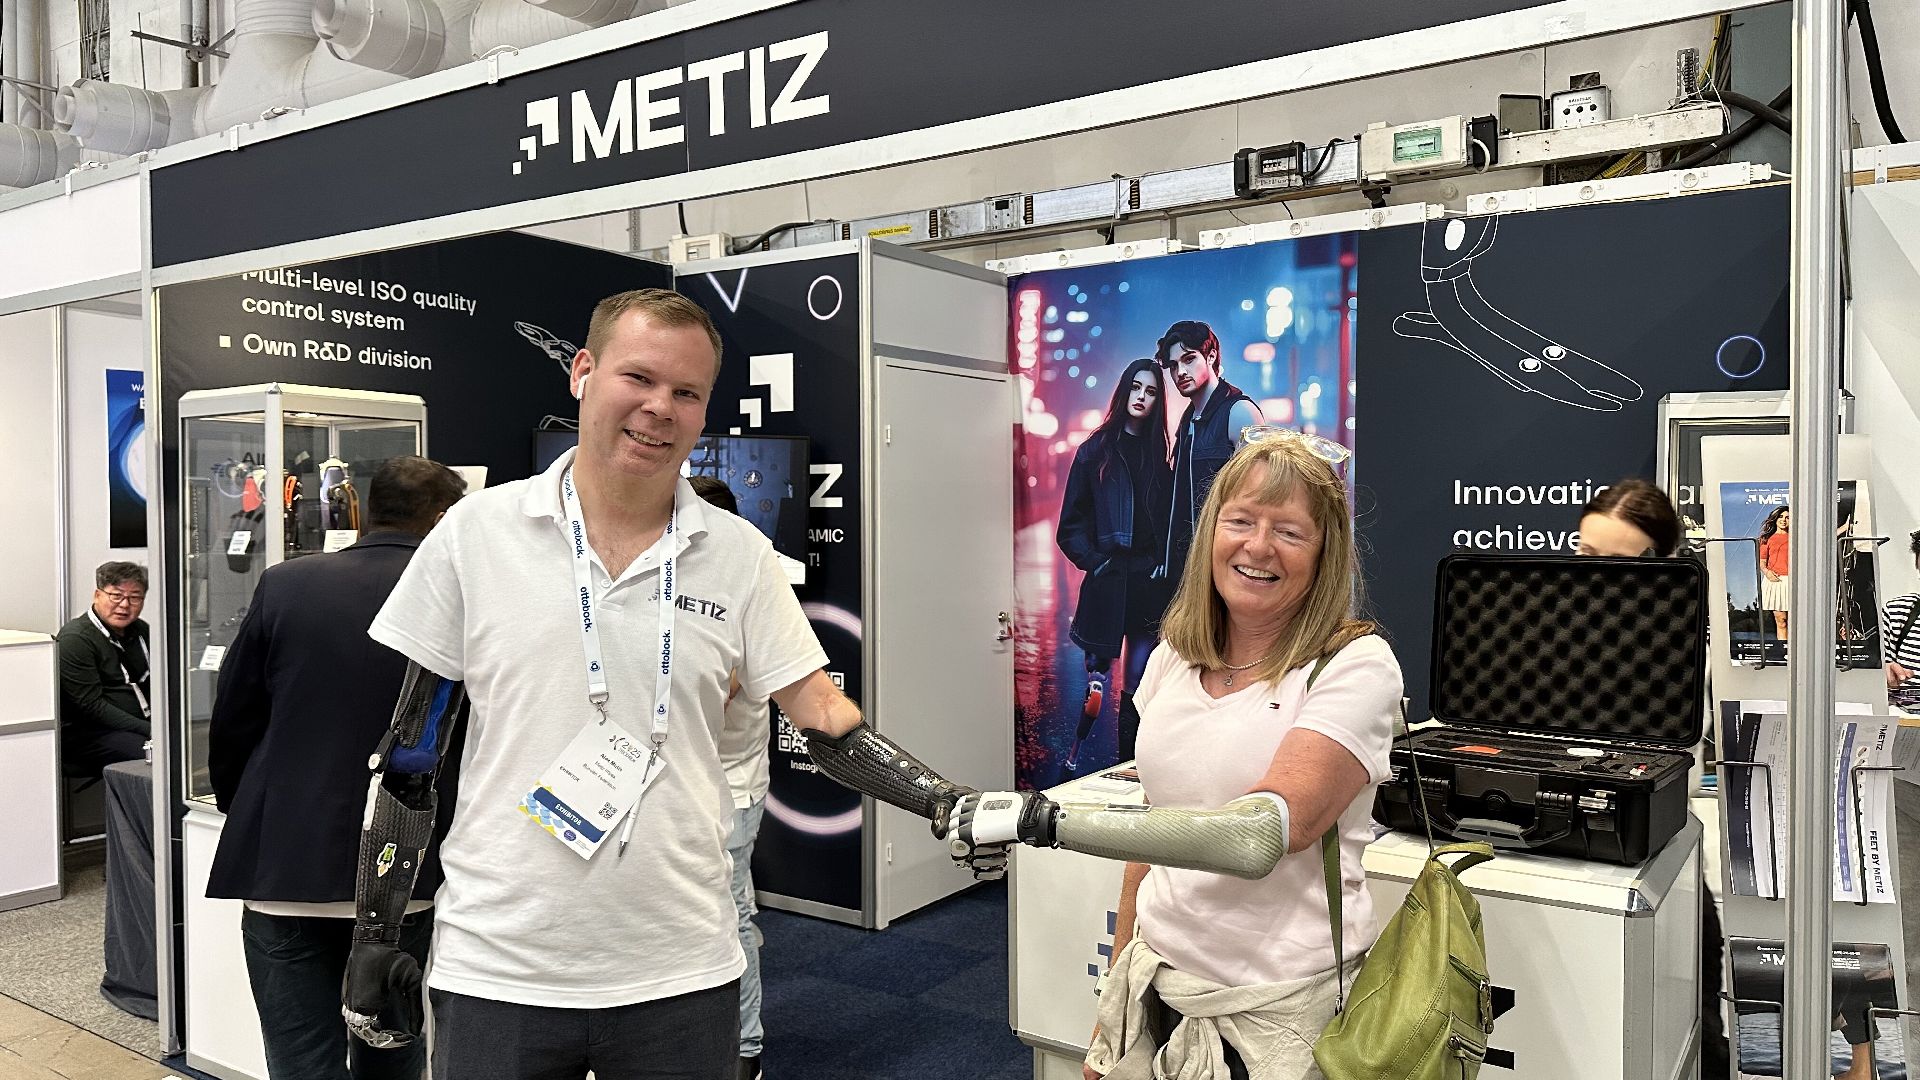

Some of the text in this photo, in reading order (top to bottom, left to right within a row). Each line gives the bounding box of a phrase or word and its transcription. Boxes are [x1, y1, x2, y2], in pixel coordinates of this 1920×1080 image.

[570, 30, 831, 164] METIZ
[242, 297, 405, 331] control system
[371, 280, 407, 303] ISO
[412, 290, 477, 316] quality
[243, 333, 432, 371] Own R&D division
[571, 520, 585, 559] ottobock.
[664, 557, 673, 601] ottobock.
[580, 586, 593, 633] ottobock.
[674, 594, 727, 622] METIZ
[662, 629, 671, 675] ottobock.
[1876, 727, 1888, 751] METIZ
[555, 803, 582, 826] EXHIBITOR
[1869, 830, 1885, 894] FEET BY METIZ
